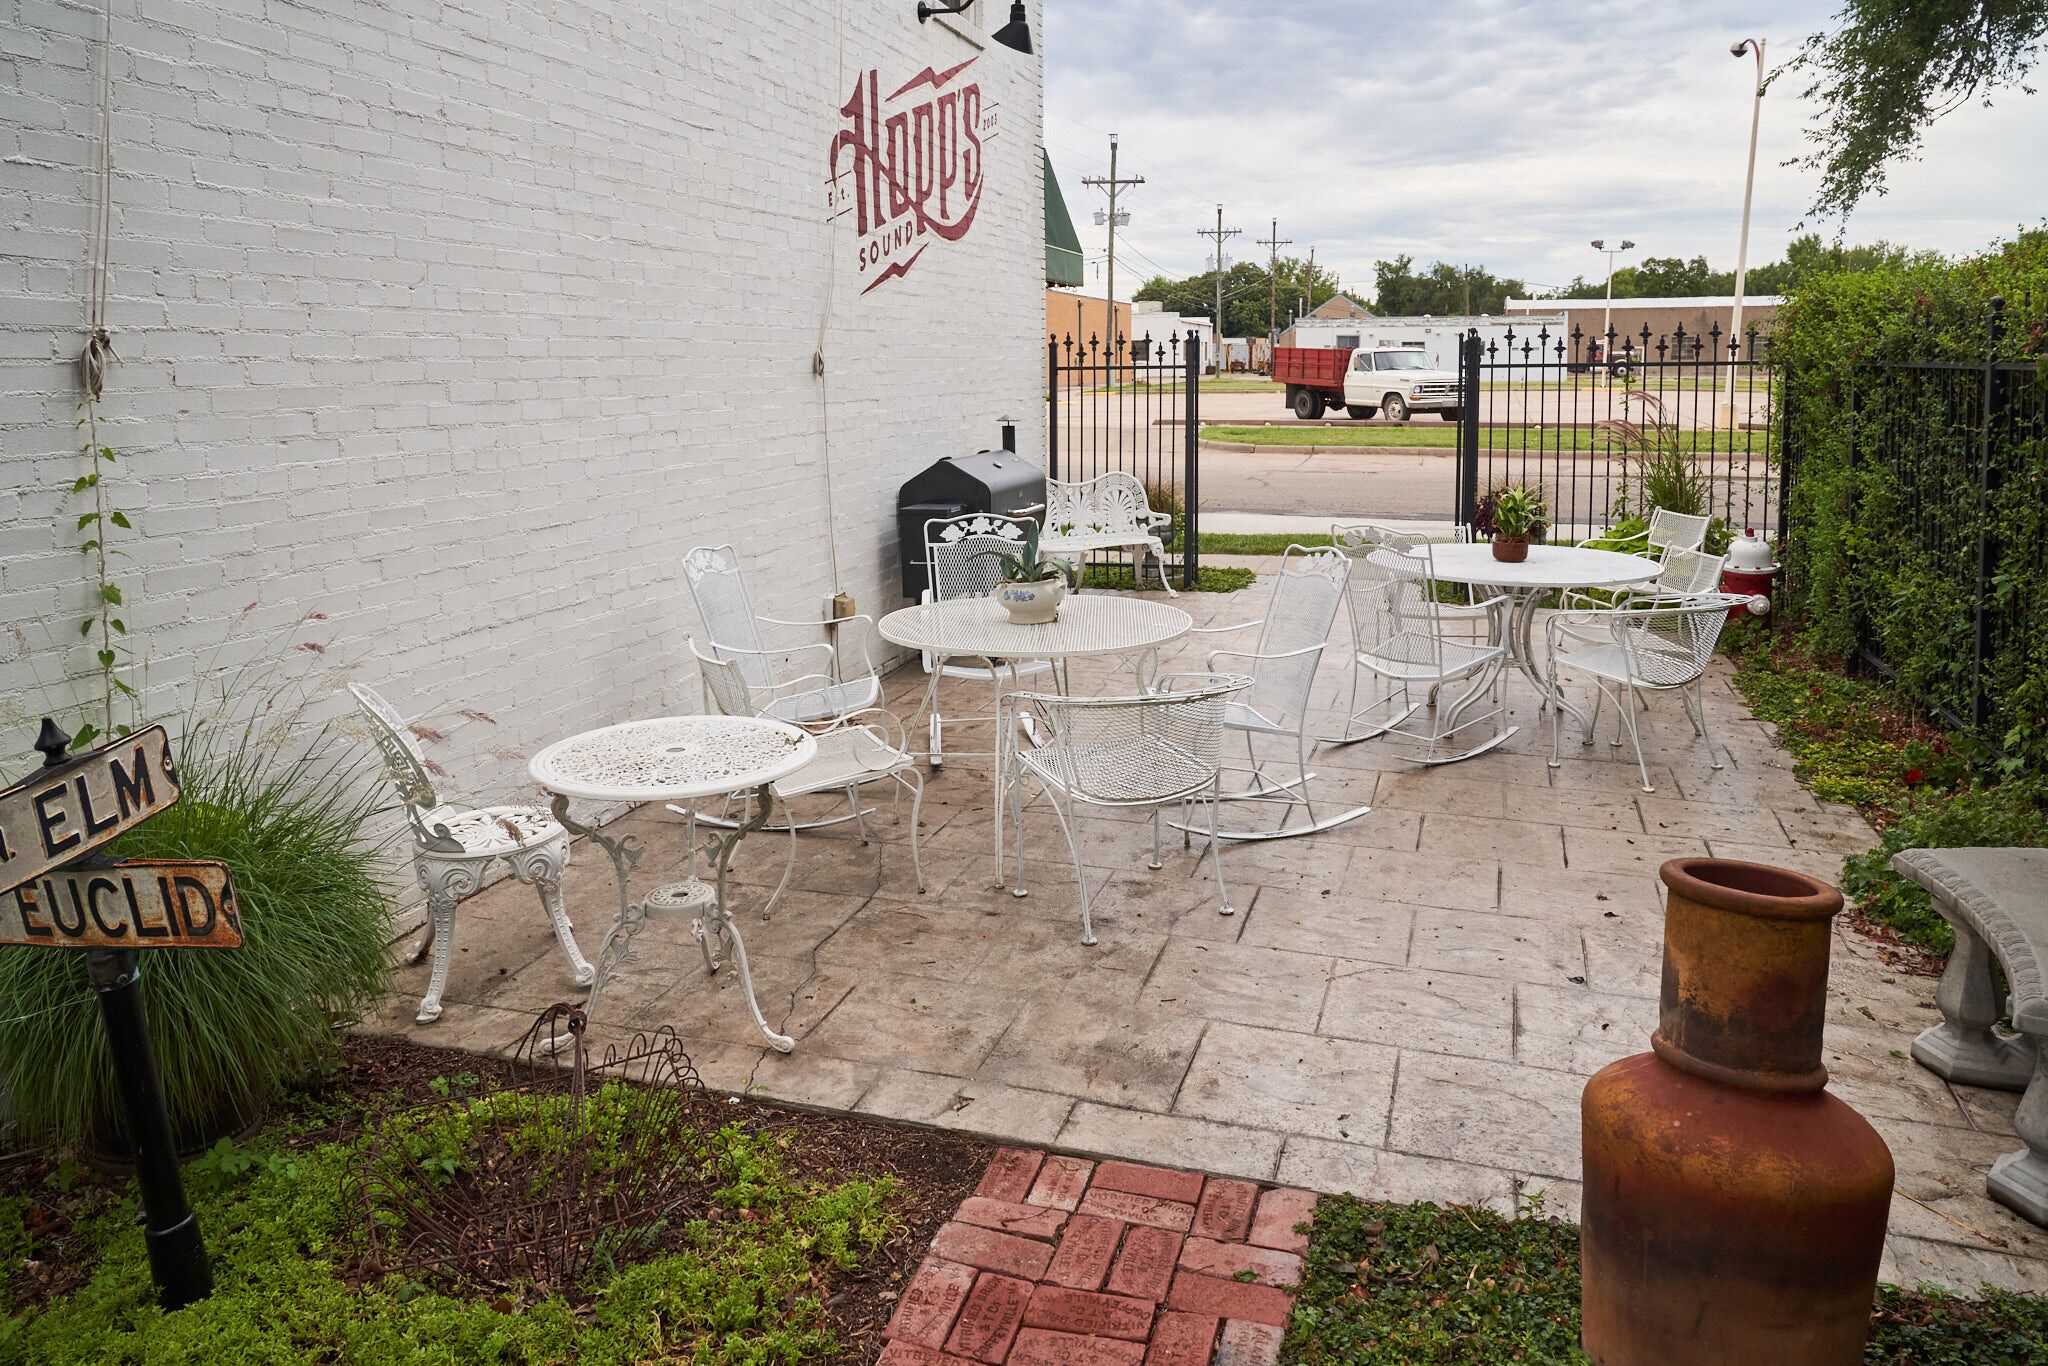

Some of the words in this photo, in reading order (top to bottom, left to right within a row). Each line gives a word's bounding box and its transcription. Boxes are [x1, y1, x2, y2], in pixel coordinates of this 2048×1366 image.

[828, 187, 849, 207] Et.
[860, 221, 913, 272] SOUND
[33, 744, 156, 858] ELM
[15, 876, 216, 938] EUCLID
